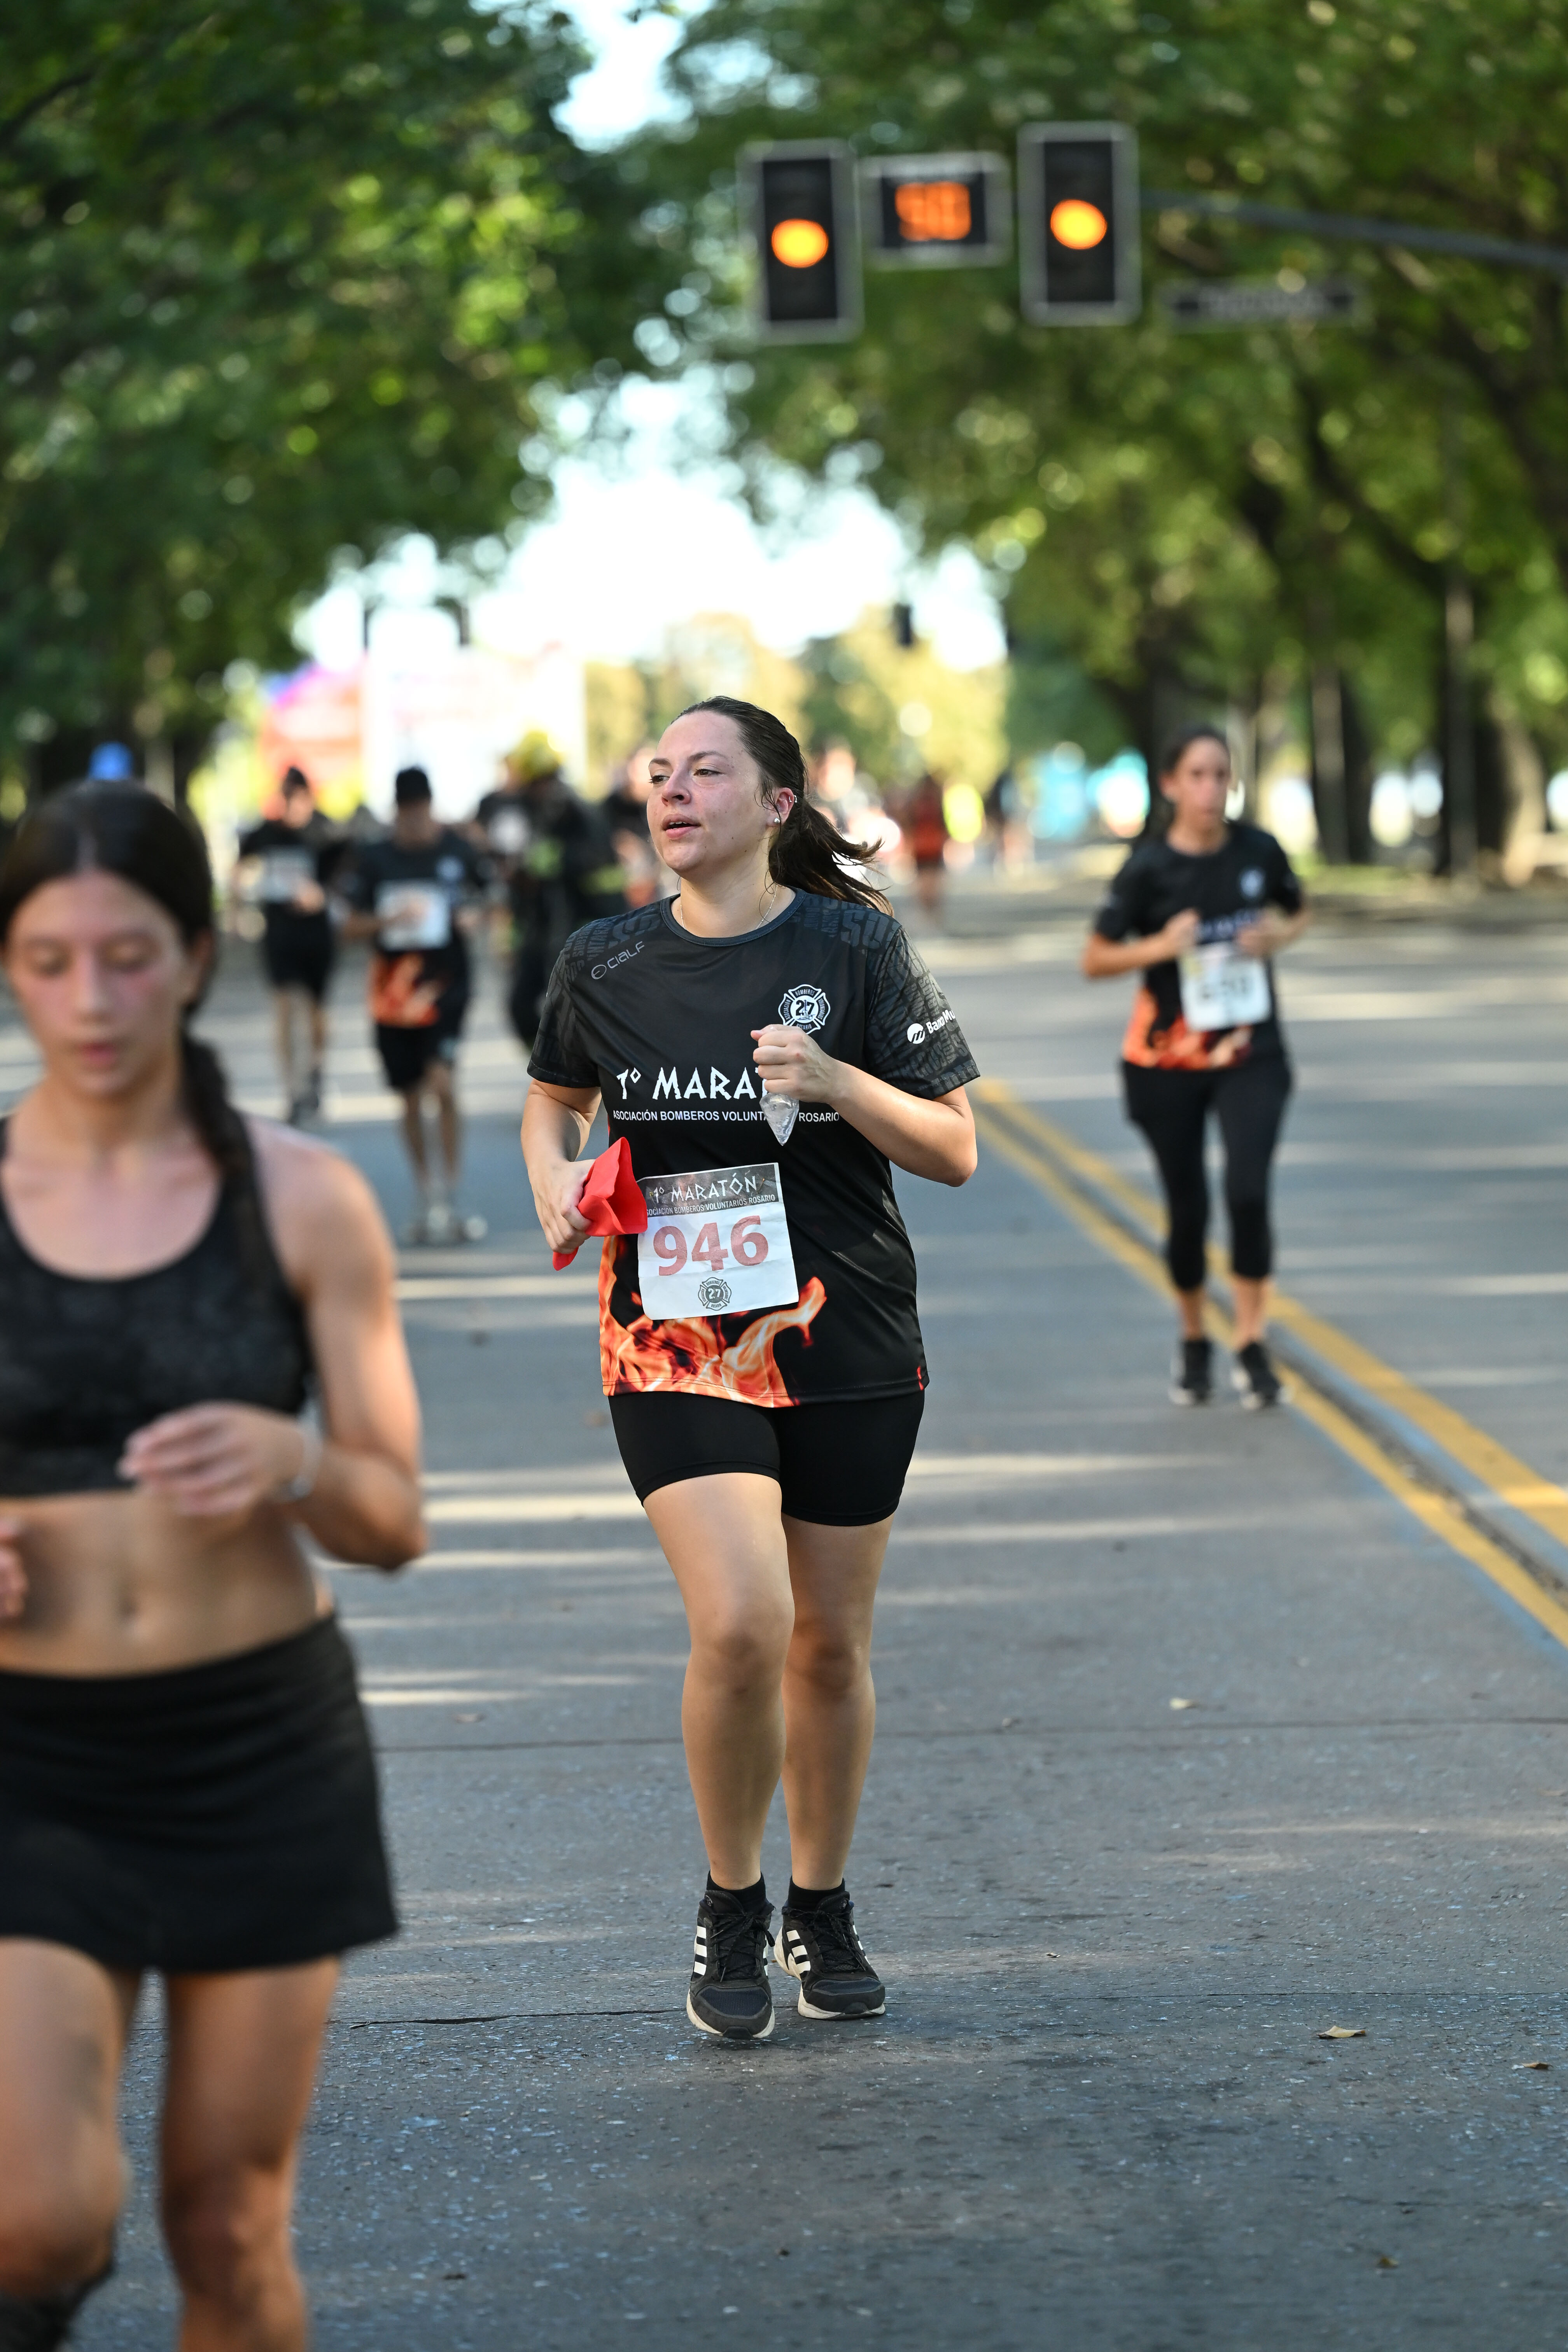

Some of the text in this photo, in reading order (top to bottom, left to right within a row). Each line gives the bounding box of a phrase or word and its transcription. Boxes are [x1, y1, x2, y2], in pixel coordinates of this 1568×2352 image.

[796, 999, 815, 1016] 27
[652, 1066, 768, 1100] MARA
[613, 1109, 658, 1121] ASOCIACIÓN
[660, 1111, 719, 1121] BOMBEROS
[799, 1112, 840, 1122] ROSARIO
[671, 1172, 757, 1202] MARATÓN
[674, 1205, 704, 1214] BOMBEROS
[705, 1199, 747, 1211] VOLUNTARIOS
[749, 1194, 775, 1204] ROSARIO
[653, 1215, 768, 1276] 946
[708, 1288, 721, 1300] 27
